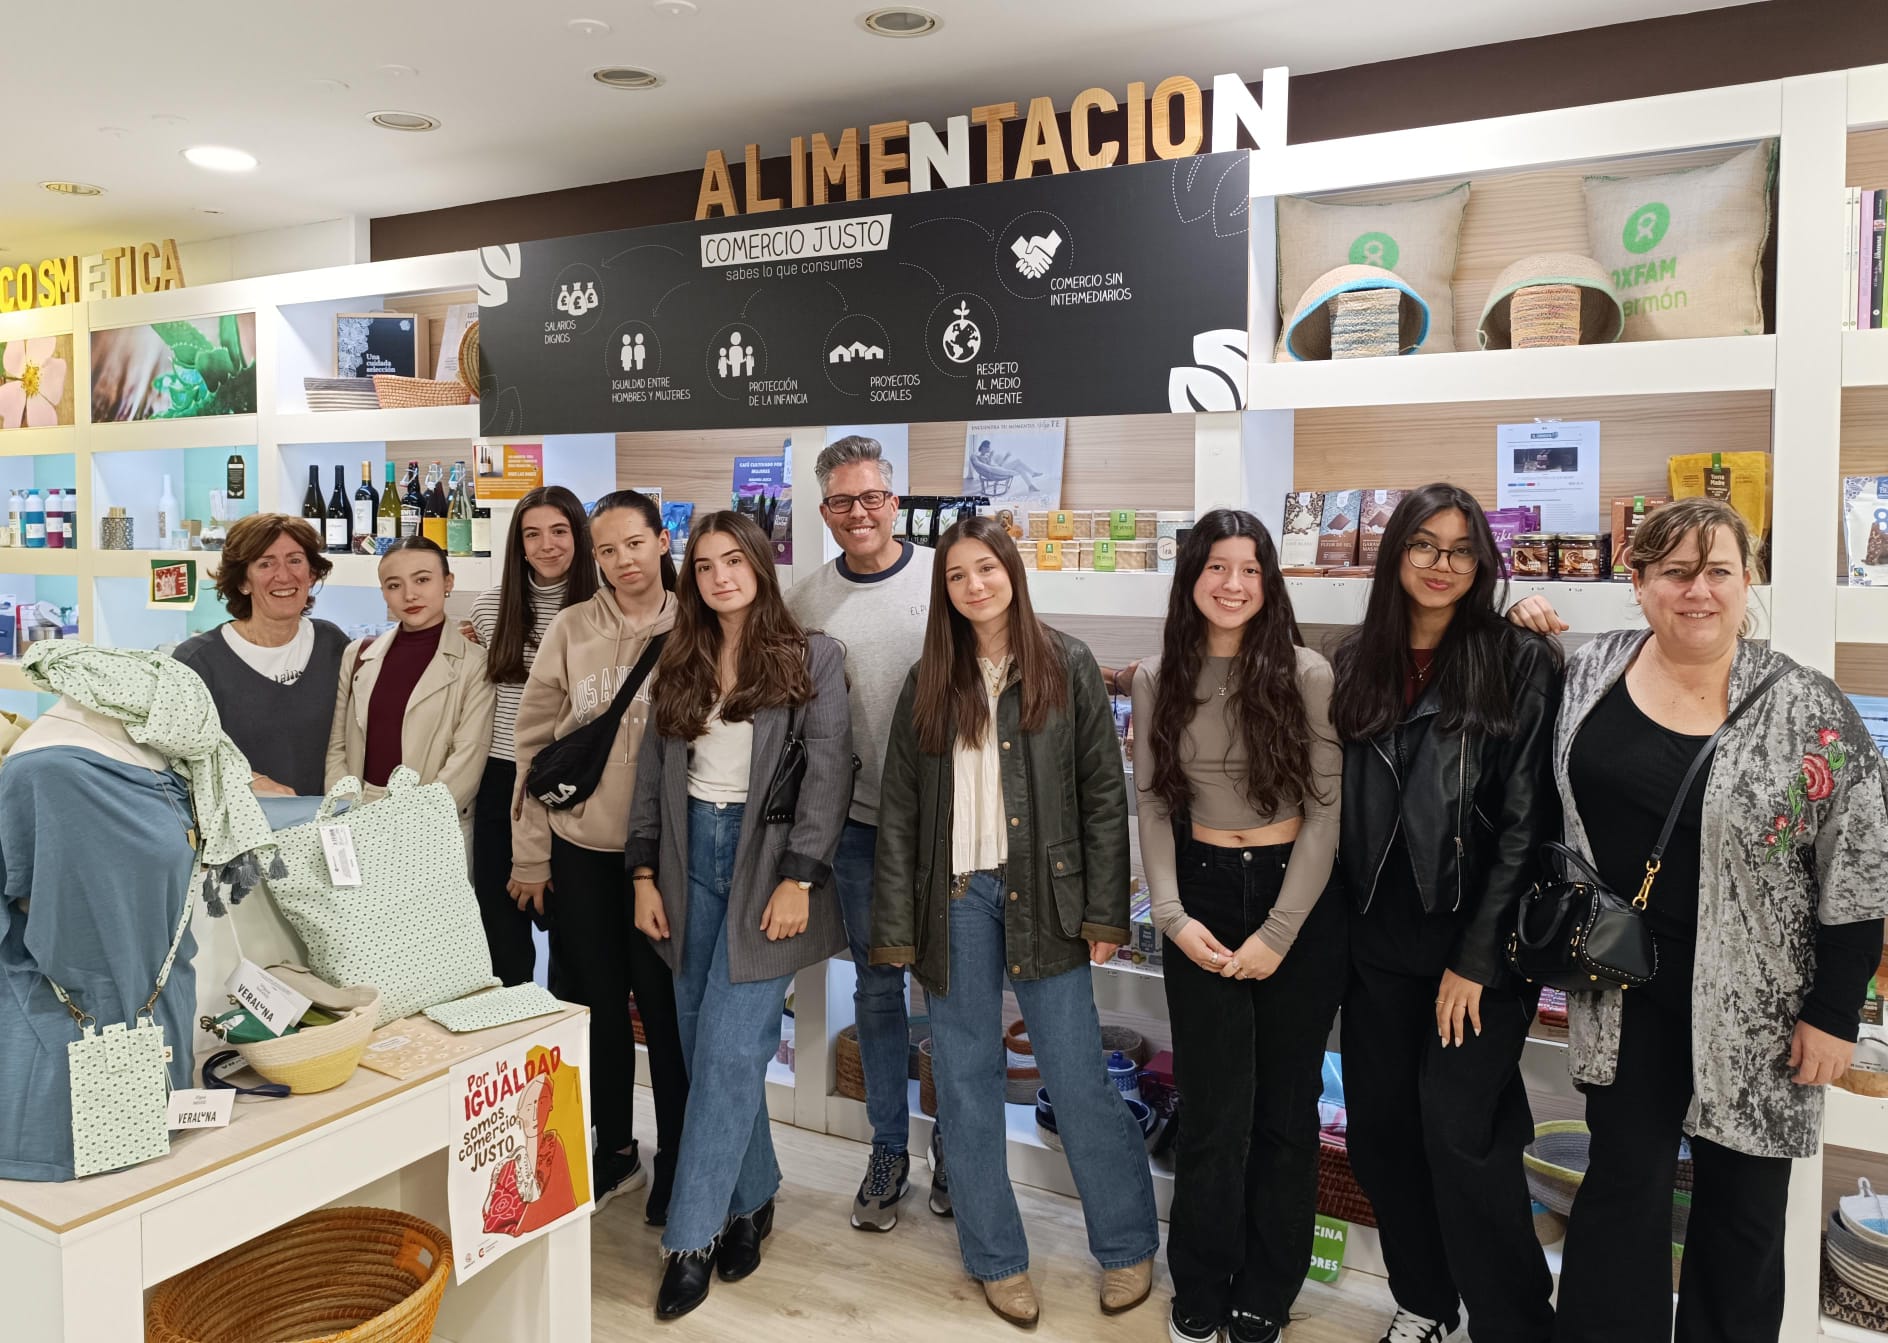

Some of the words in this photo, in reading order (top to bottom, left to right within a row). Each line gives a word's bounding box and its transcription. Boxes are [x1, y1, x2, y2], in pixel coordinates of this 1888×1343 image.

[694, 66, 1289, 221] ALIMENTACION
[705, 229, 805, 264] COMERCIO
[812, 219, 884, 253] JUSTO
[0, 239, 185, 313] COSMETICA
[725, 264, 760, 281] sabes
[762, 262, 773, 278] lo
[776, 263, 798, 279] que
[801, 257, 863, 274] consumes
[1050, 274, 1102, 291] COMERCIO
[1105, 272, 1123, 286] SIN
[1050, 288, 1132, 307] INTERMEDIARIOS
[1622, 286, 1688, 317] ermón
[544, 320, 577, 332] SALARIOS
[544, 333, 571, 345] DIGNOS
[366, 353, 380, 361] Una
[976, 362, 1019, 376] RESPETO
[612, 378, 646, 390] IGUALDAD
[647, 376, 671, 388] ENTRE
[748, 377, 798, 393] PROTECCIÓN
[870, 374, 921, 388] PROYECTOS
[976, 378, 987, 391] AL
[990, 377, 1021, 390] MEDIO
[611, 391, 647, 403] HOMBRES
[648, 390, 653, 401] Y
[655, 388, 691, 401] MUJERES
[748, 394, 758, 407] DE
[761, 395, 772, 406] LA
[773, 393, 808, 405] INFANCIA
[869, 389, 912, 402] SOCIALES
[976, 392, 1023, 406] AMBIENTE
[538, 782, 577, 808] FILA
[464, 1046, 561, 1122] IGUALDAD
[467, 1071, 489, 1093] Por
[496, 1060, 508, 1076] la
[463, 1106, 505, 1145] somos
[458, 1114, 518, 1162] comercio
[471, 1134, 514, 1172] JUSTO
[1314, 1225, 1343, 1242] CINA
[1310, 1254, 1338, 1271] ORES
